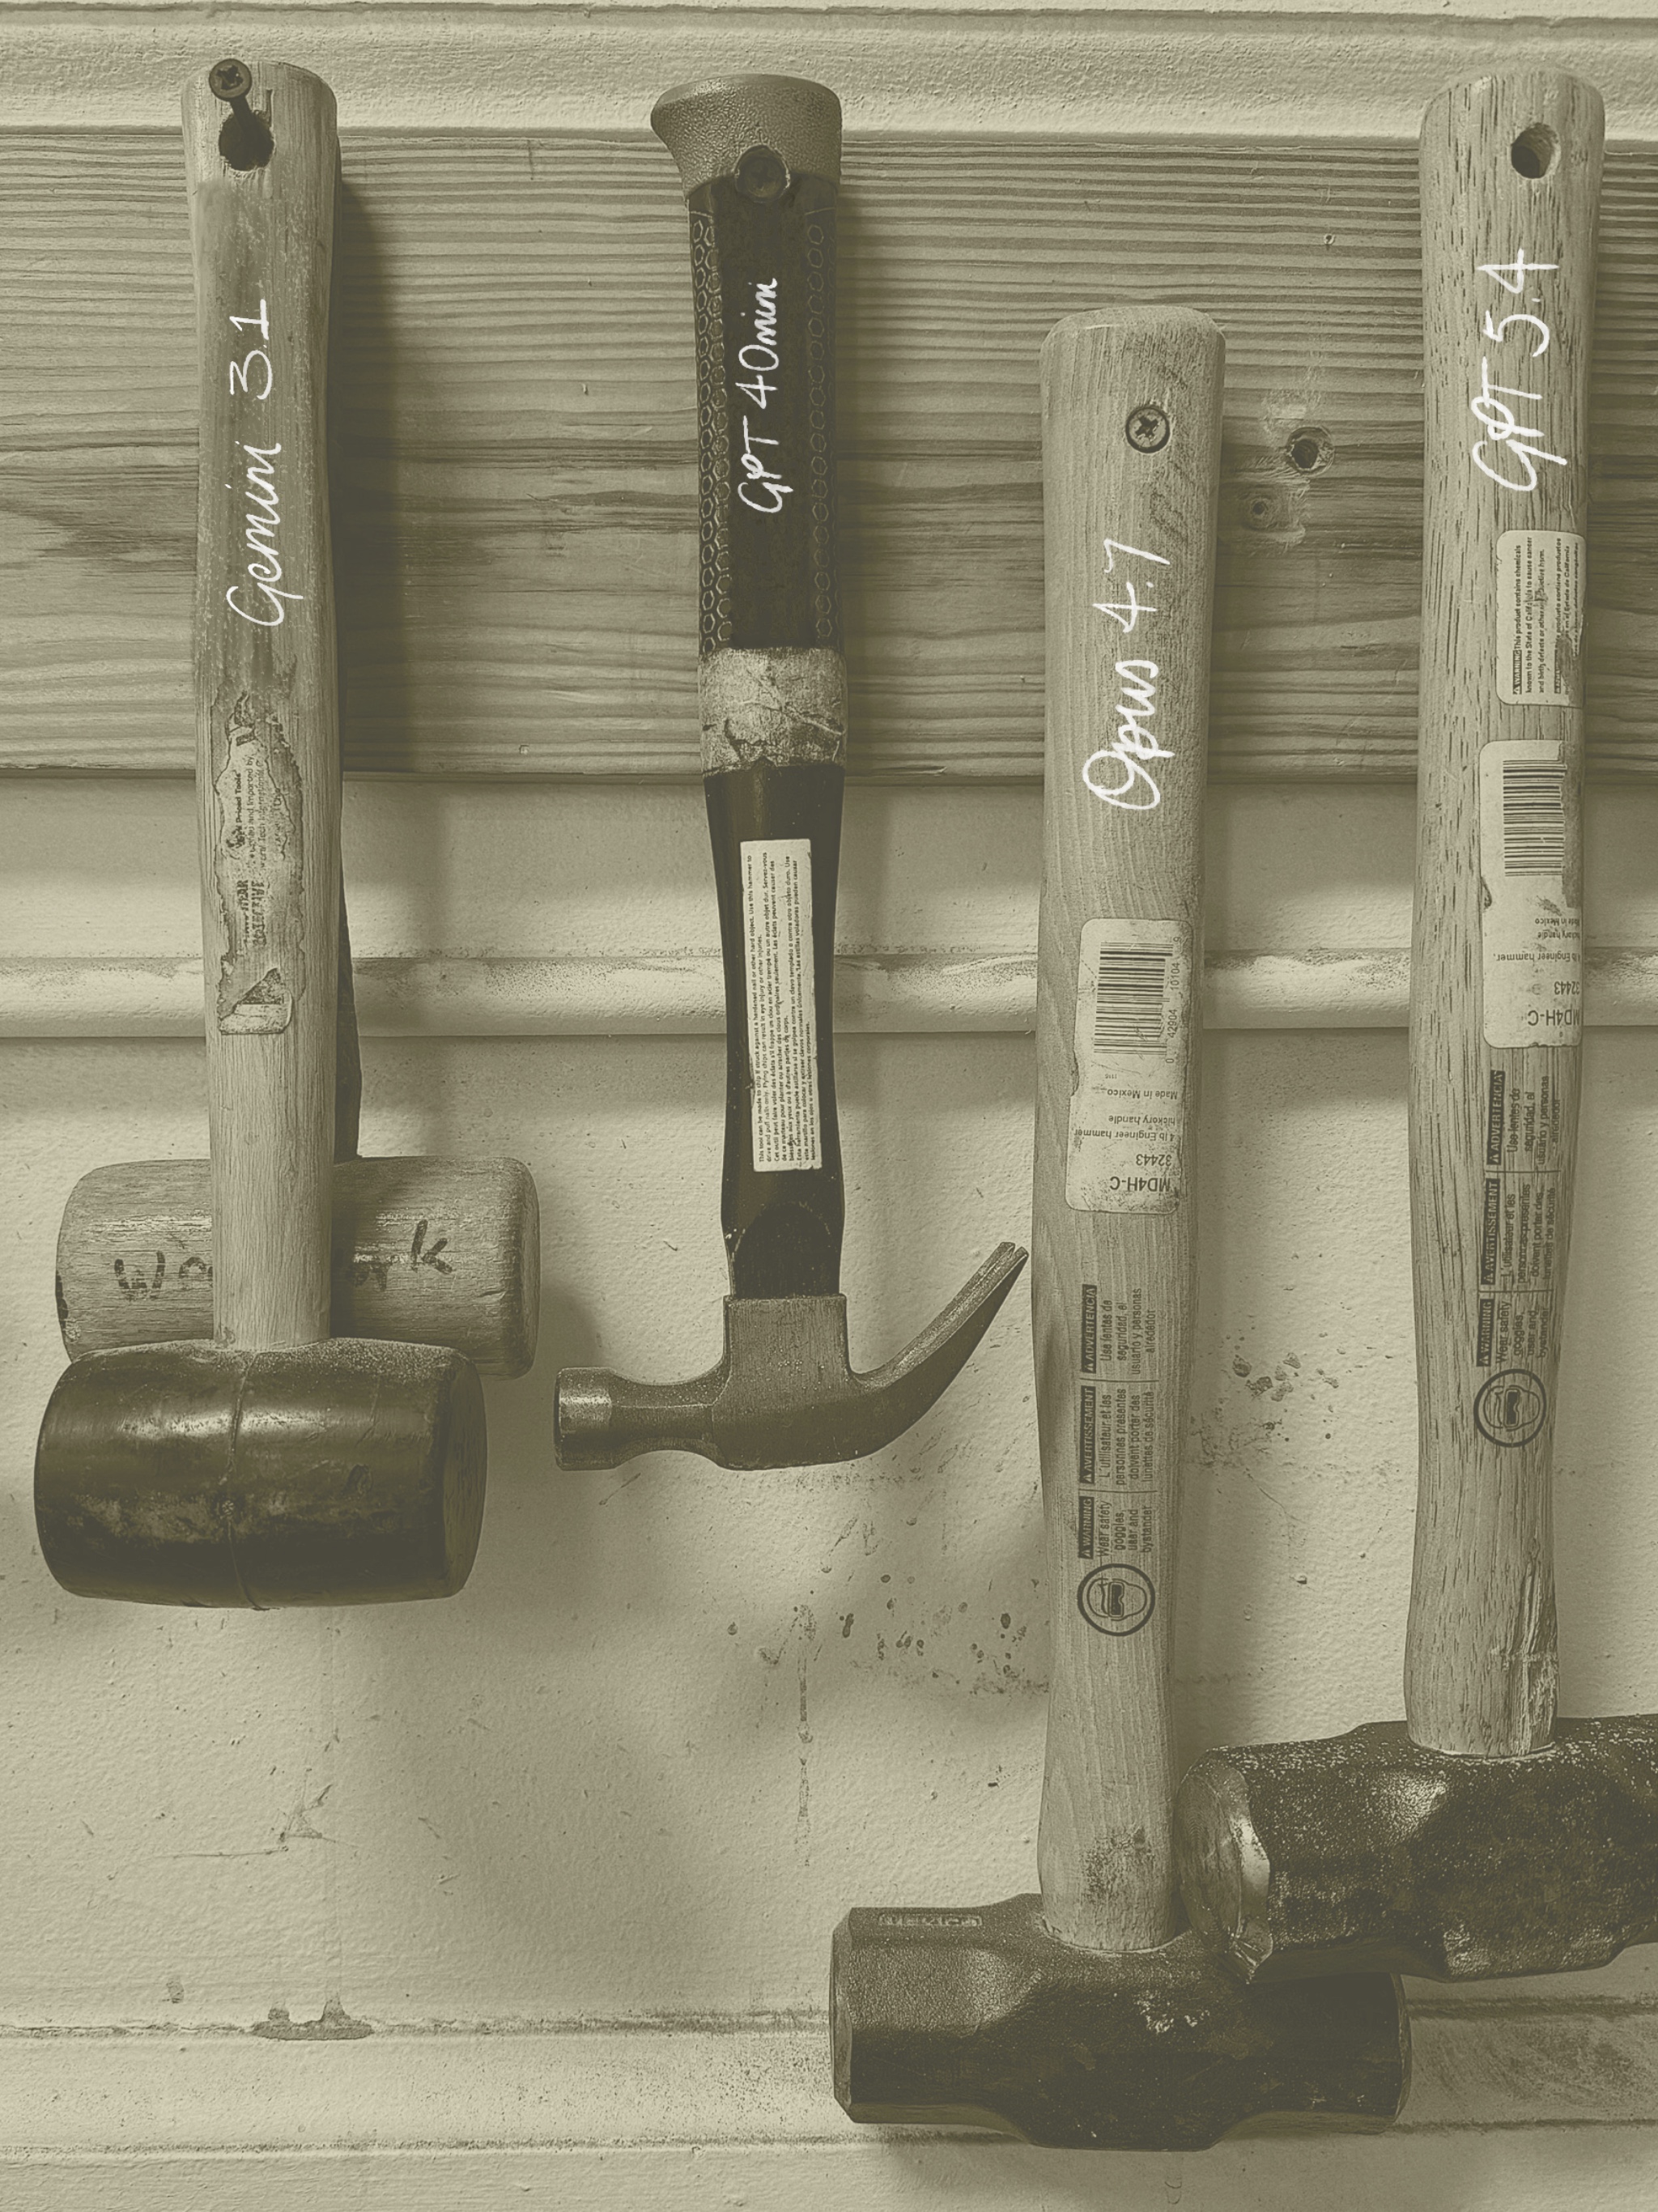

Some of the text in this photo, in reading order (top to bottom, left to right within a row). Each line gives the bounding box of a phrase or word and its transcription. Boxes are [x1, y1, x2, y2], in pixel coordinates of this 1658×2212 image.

[1535, 917, 1559, 926] Mexico
[1537, 950, 1571, 961] Engineer
[1170, 962, 1180, 990] 10104
[1167, 1008, 1177, 1037] 42904
[1107, 1088, 1177, 1099] Made in Mexico
[1107, 1114, 1175, 1125] hickory handle
[1490, 1074, 1503, 1151] ADVERTENCIA
[1114, 1129, 1156, 1140] Engineer
[1158, 1132, 1167, 1141] lb
[1135, 1153, 1171, 1166] 32443
[1109, 1176, 1171, 1192] MD4H-C
[1485, 1180, 1498, 1270] AVERTISSEMENT
[1116, 1302, 1128, 1310] el
[1132, 1288, 1144, 1329] personas
[1084, 1288, 1095, 1360] ADVERTENCIA
[1099, 1300, 1112, 1360] Use lentes de
[1144, 1308, 1156, 1353] alrededor
[1480, 1300, 1491, 1353] WARNING
[1129, 1341, 1141, 1374] usuario
[1099, 1394, 1111, 1407] les
[1099, 1410, 1111, 1419] et
[1083, 1387, 1093, 1470] AVERTISSEMENT
[1128, 1394, 1141, 1478] doivent porter des
[1142, 1431, 1154, 1441] de
[1115, 1437, 1127, 1485] personnes
[1141, 1444, 1153, 1482] lunettes
[1082, 1498, 1091, 1546] WARNING
[1095, 1501, 1112, 1556] Wear safety
[1127, 1509, 1138, 1550] user and
[1140, 1505, 1154, 1552] bystander
